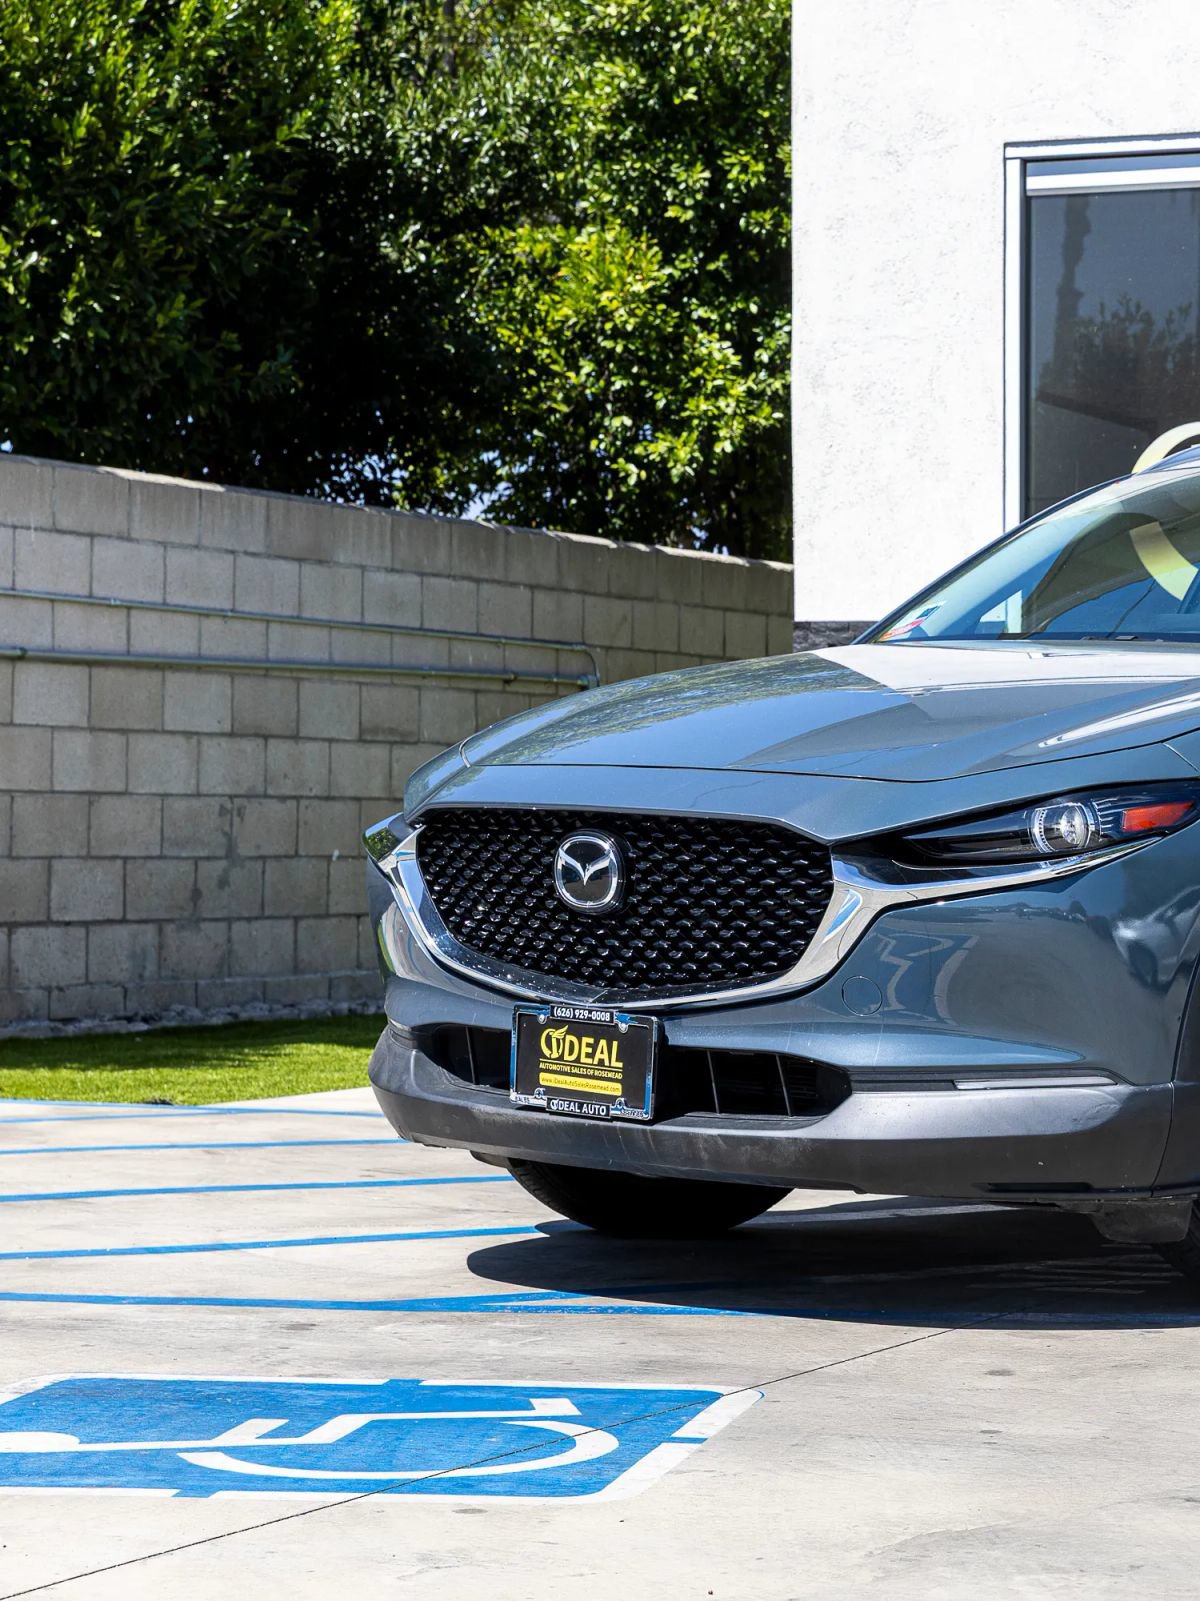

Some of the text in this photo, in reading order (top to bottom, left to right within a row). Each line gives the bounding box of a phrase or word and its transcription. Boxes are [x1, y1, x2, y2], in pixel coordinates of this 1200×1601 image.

[554, 1006, 611, 1021] (626) 929-0008
[539, 1062, 571, 1072] AUTOMOTIVE
[571, 1067, 587, 1075] SALES
[595, 1071, 623, 1079] ROSEMEAD
[582, 1103, 607, 1115] AUTO
